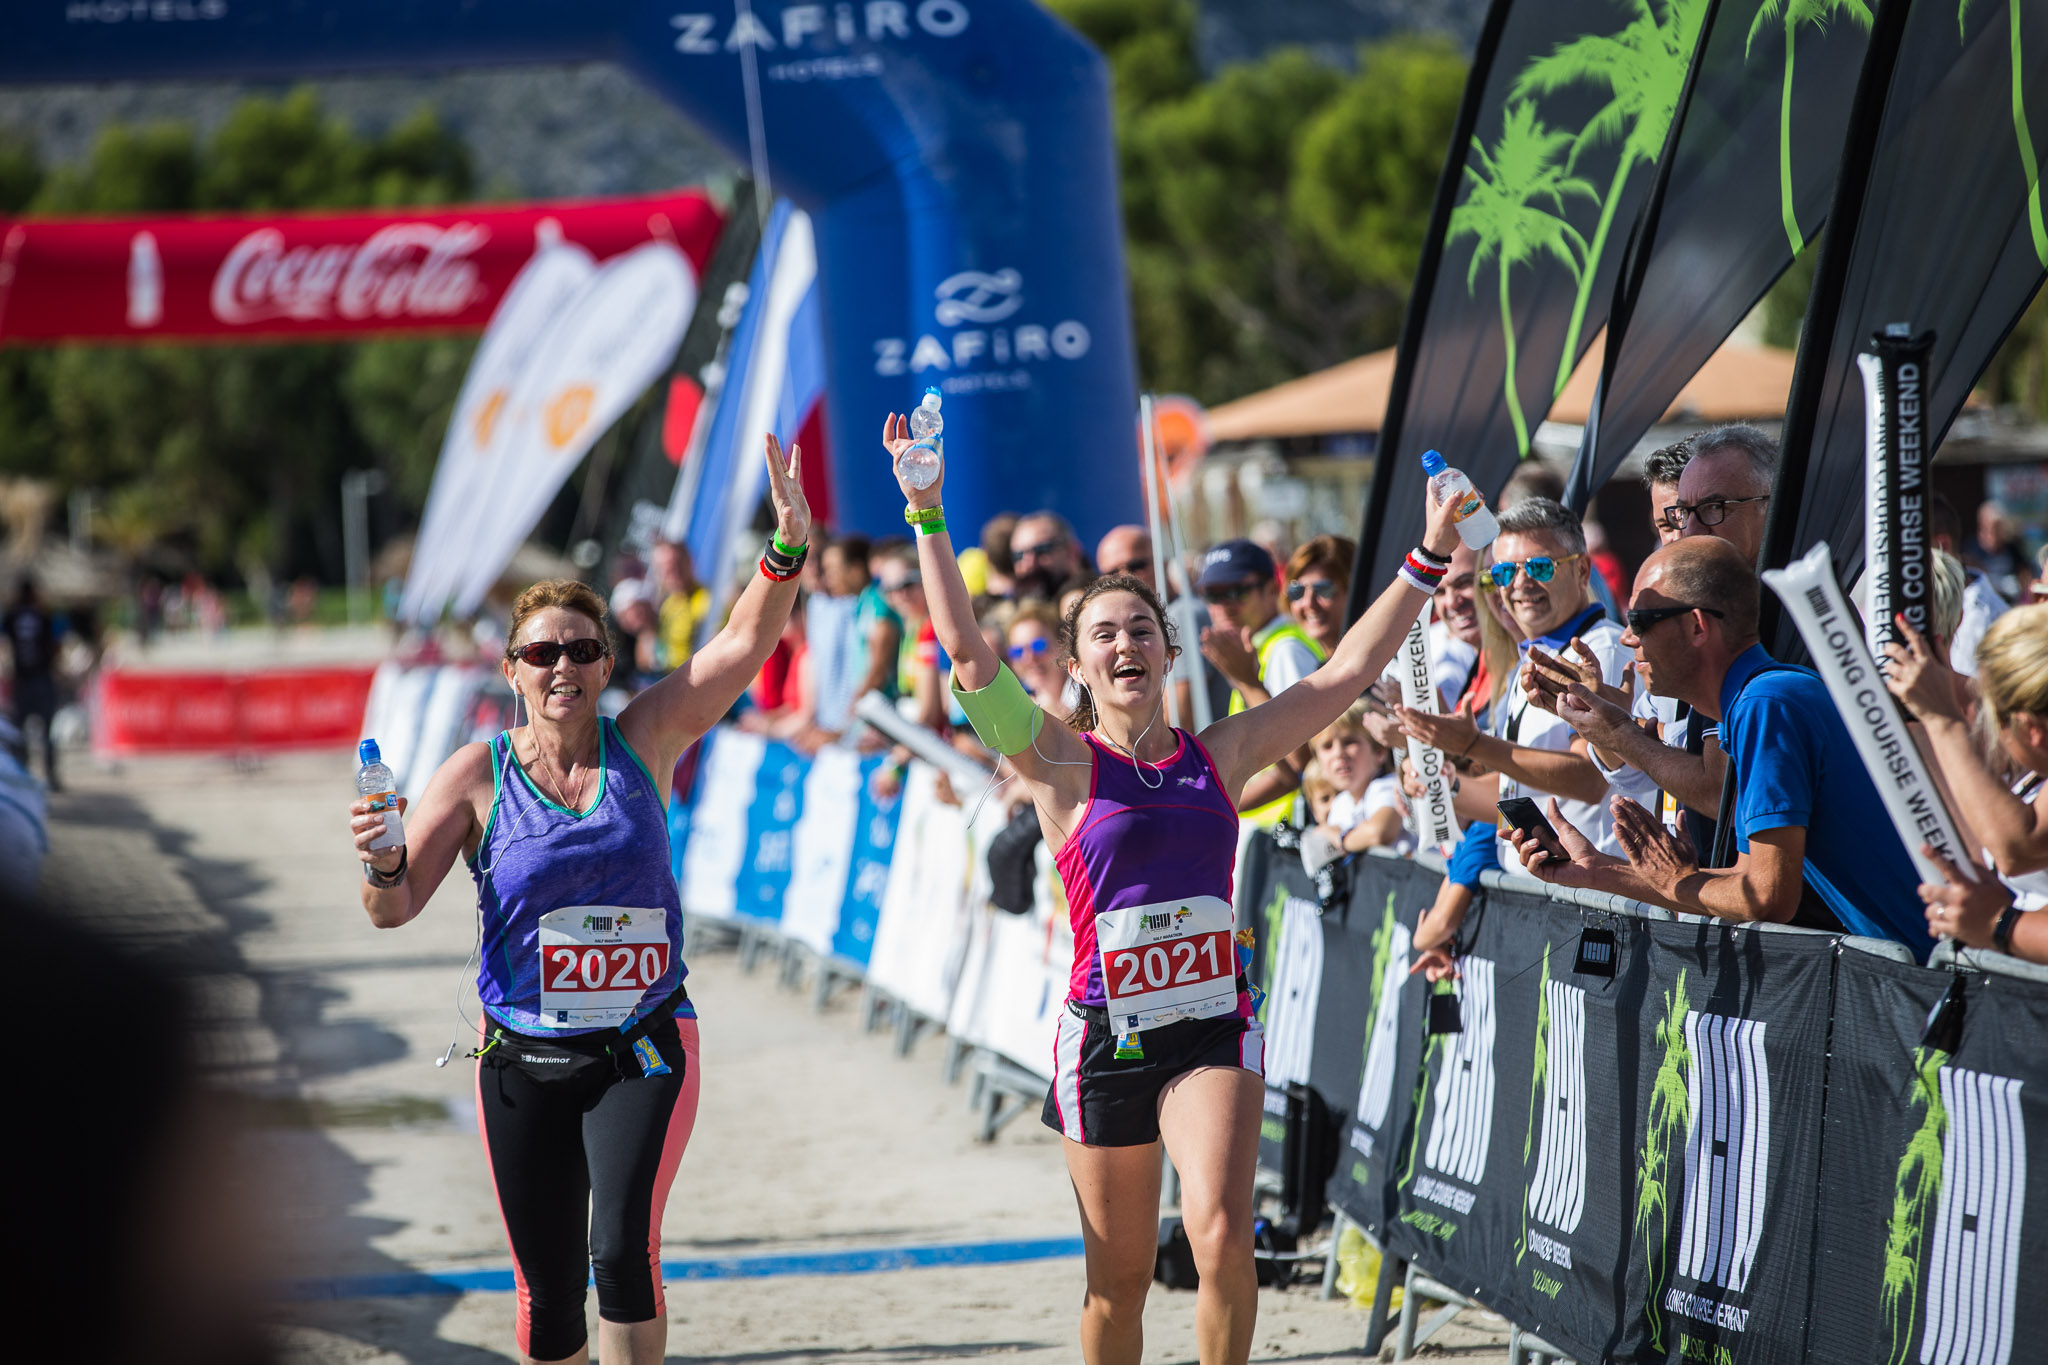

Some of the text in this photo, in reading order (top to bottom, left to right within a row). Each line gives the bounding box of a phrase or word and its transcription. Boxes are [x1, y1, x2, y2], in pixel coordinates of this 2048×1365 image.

[1898, 362, 1922, 490] WEEKEND
[1901, 494, 1925, 597] COURSE
[1820, 616, 1956, 863] LONG COURSE WEEK
[1431, 778, 1448, 827] LONG
[551, 947, 661, 989] 2020
[1113, 935, 1220, 995] 2021
[532, 1056, 571, 1064] karrimor
[1665, 1287, 1686, 1315] LONG
[1684, 1293, 1714, 1324] COURSE
